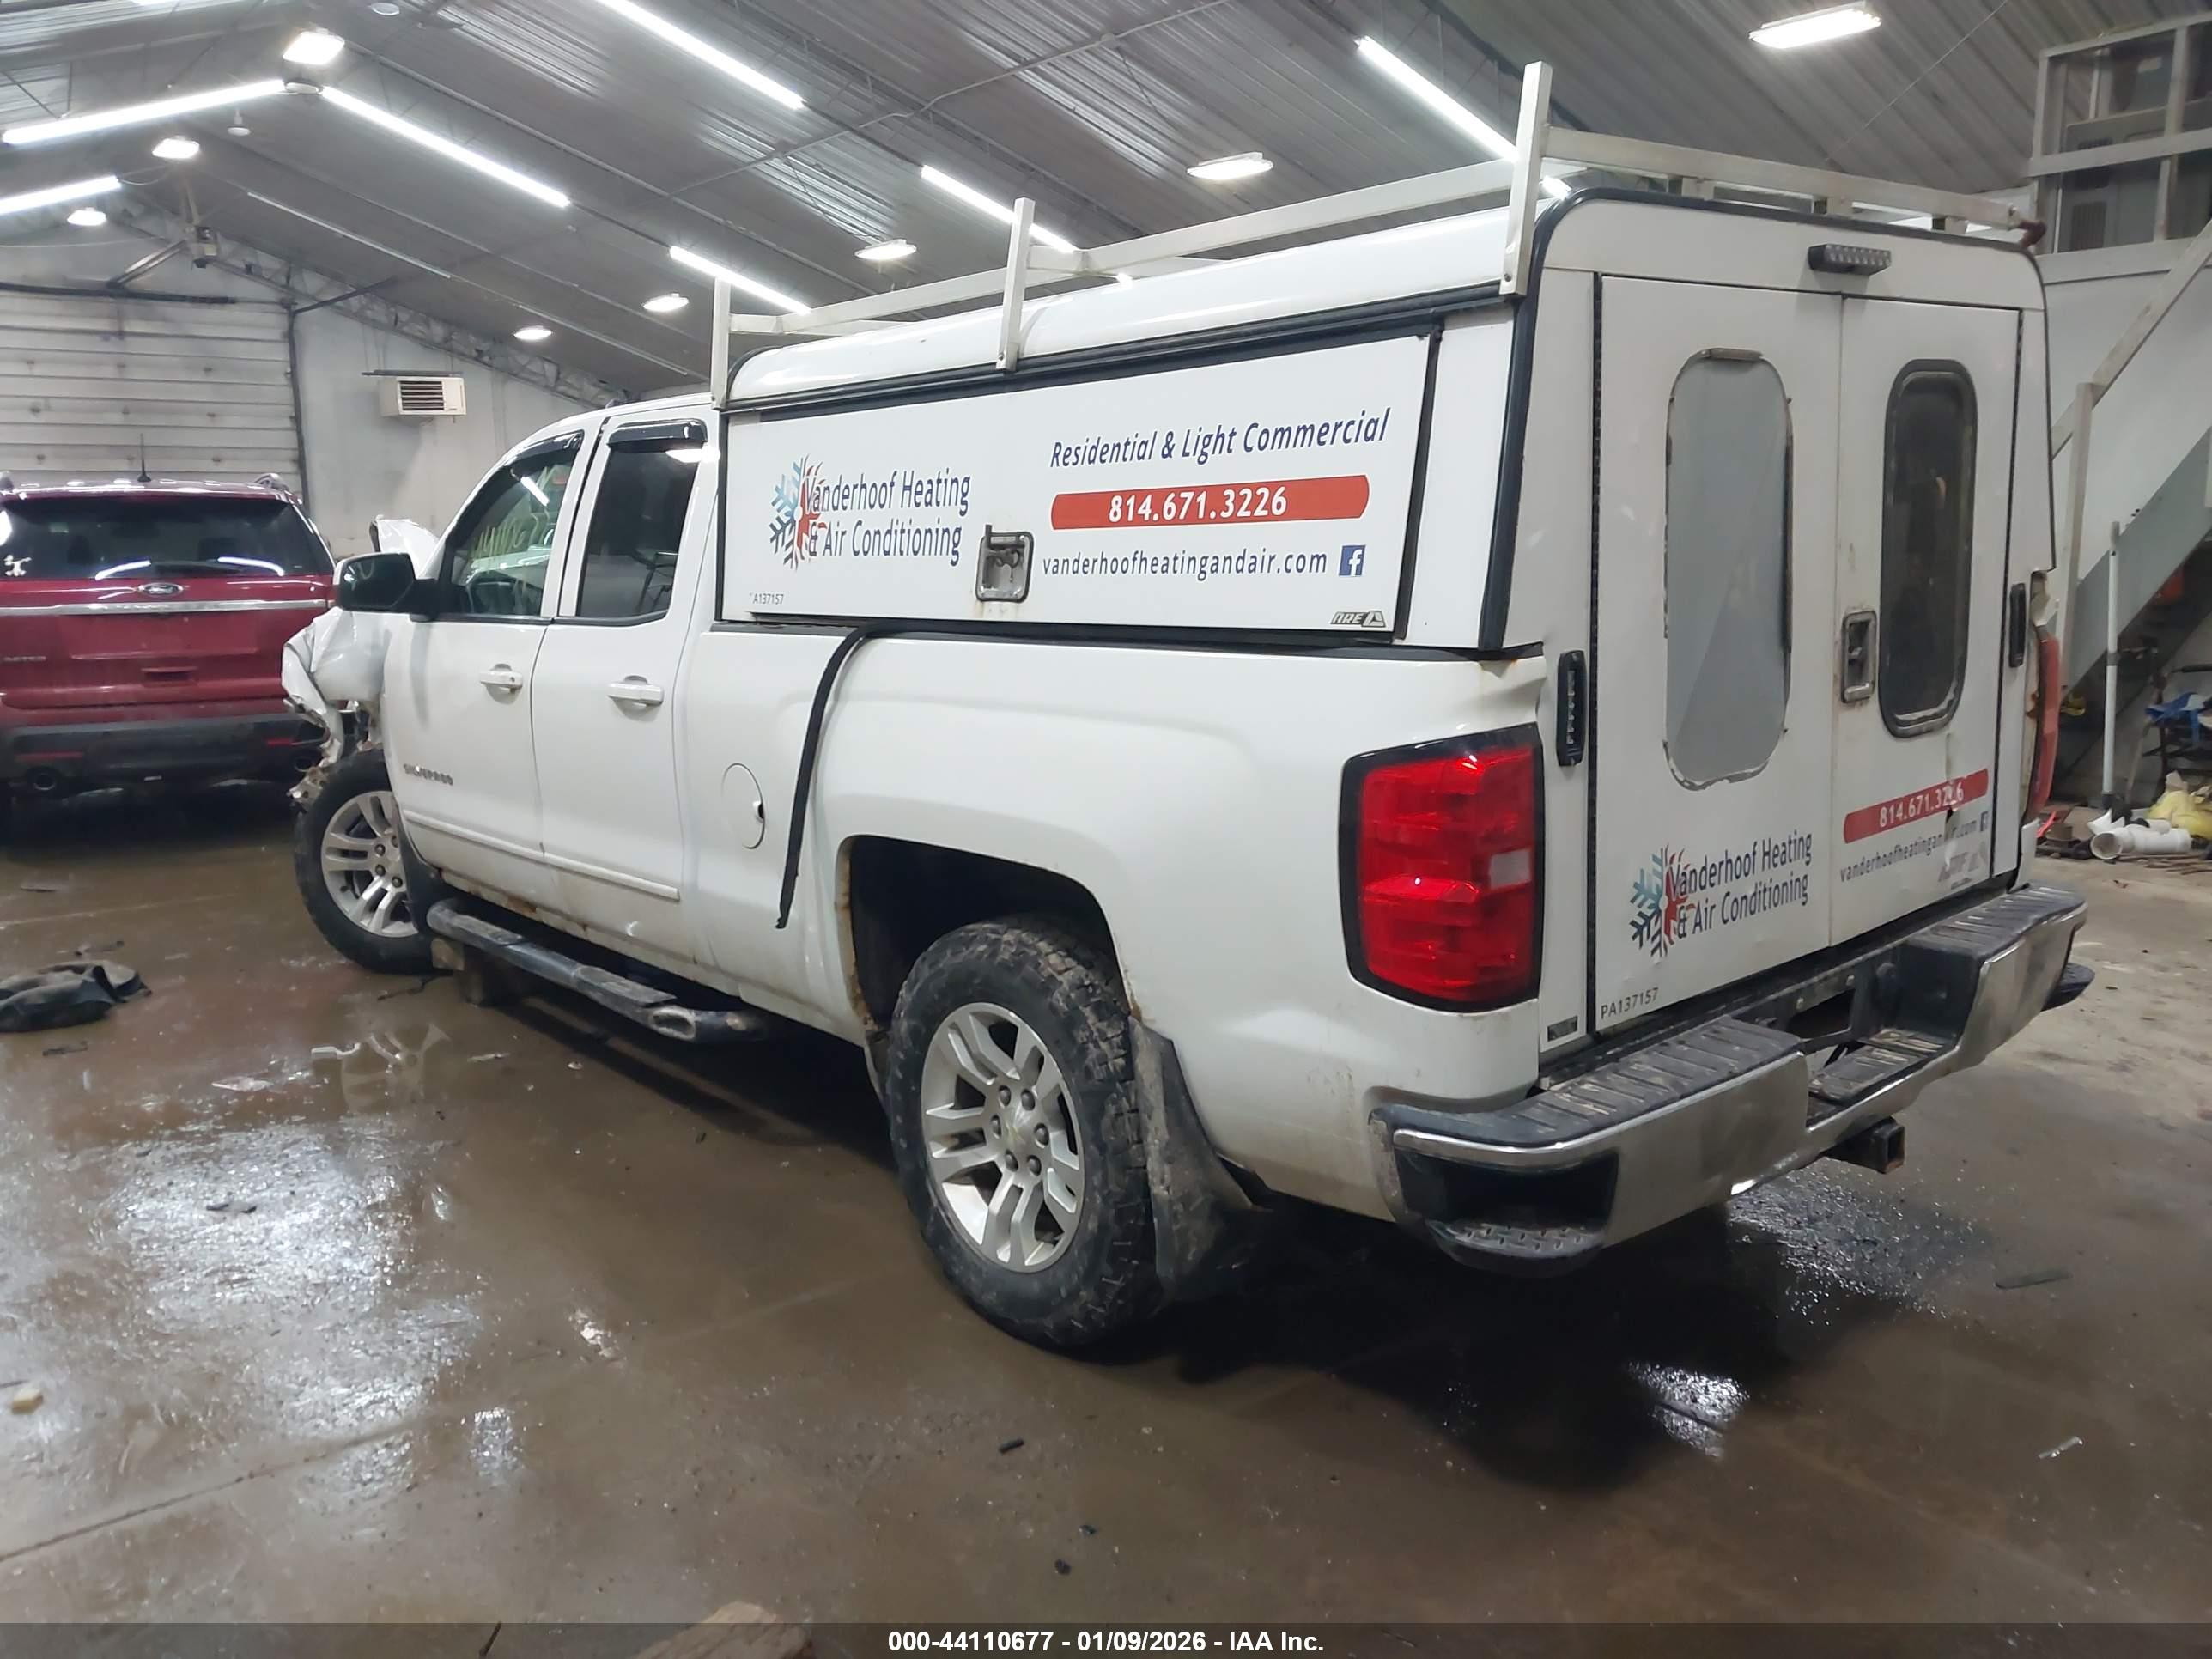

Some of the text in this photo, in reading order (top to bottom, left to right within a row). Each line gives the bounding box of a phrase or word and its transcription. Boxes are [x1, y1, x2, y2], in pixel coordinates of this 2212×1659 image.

[1050, 407, 1391, 468] Residential & Light Commercial
[805, 467, 971, 517] Vanderhoof Heating
[1108, 485, 1288, 523] 814.671.3226
[808, 517, 963, 568] & Air Conditioning
[1042, 548, 1328, 581] vanderhoofheatingandair.com
[1669, 830, 1813, 899] Vanderhoof Heating
[1677, 871, 1808, 939] & Air Conditioning
[1600, 987, 1660, 1020] PA137157
